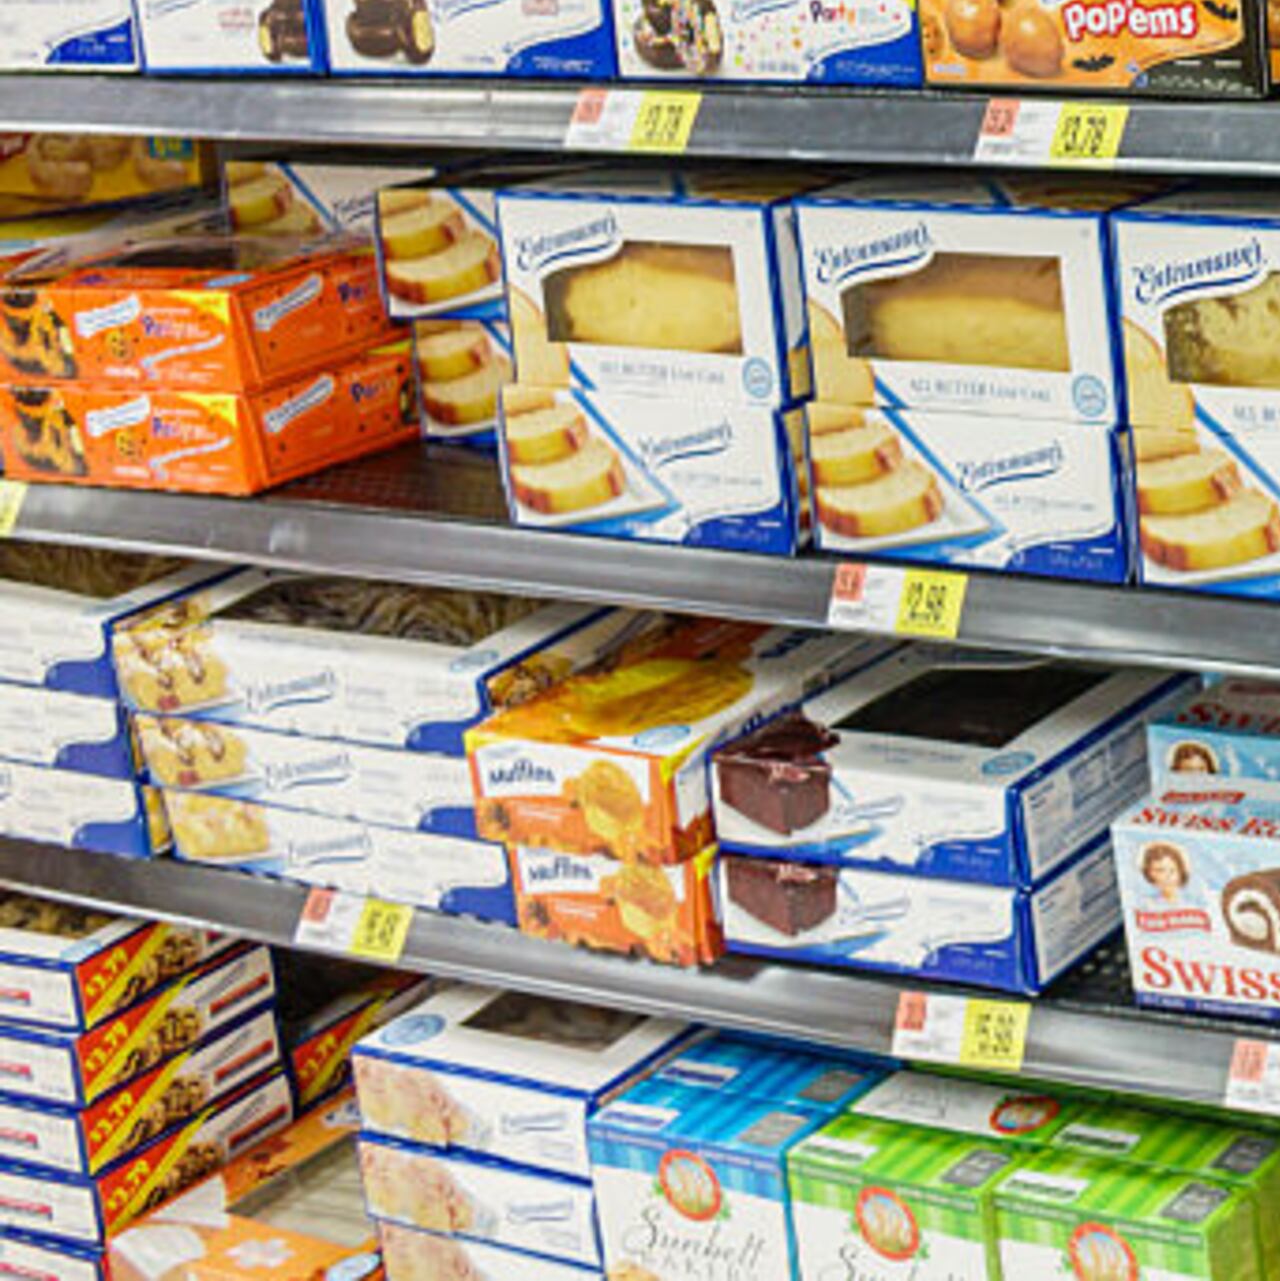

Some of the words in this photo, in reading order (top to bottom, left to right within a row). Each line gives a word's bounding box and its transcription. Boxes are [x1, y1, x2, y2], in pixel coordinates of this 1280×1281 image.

[809, 0, 856, 25] Party
[1133, 238, 1264, 305] Entenmann's
[488, 758, 555, 787] Muffins
[526, 855, 594, 883] Muffins
